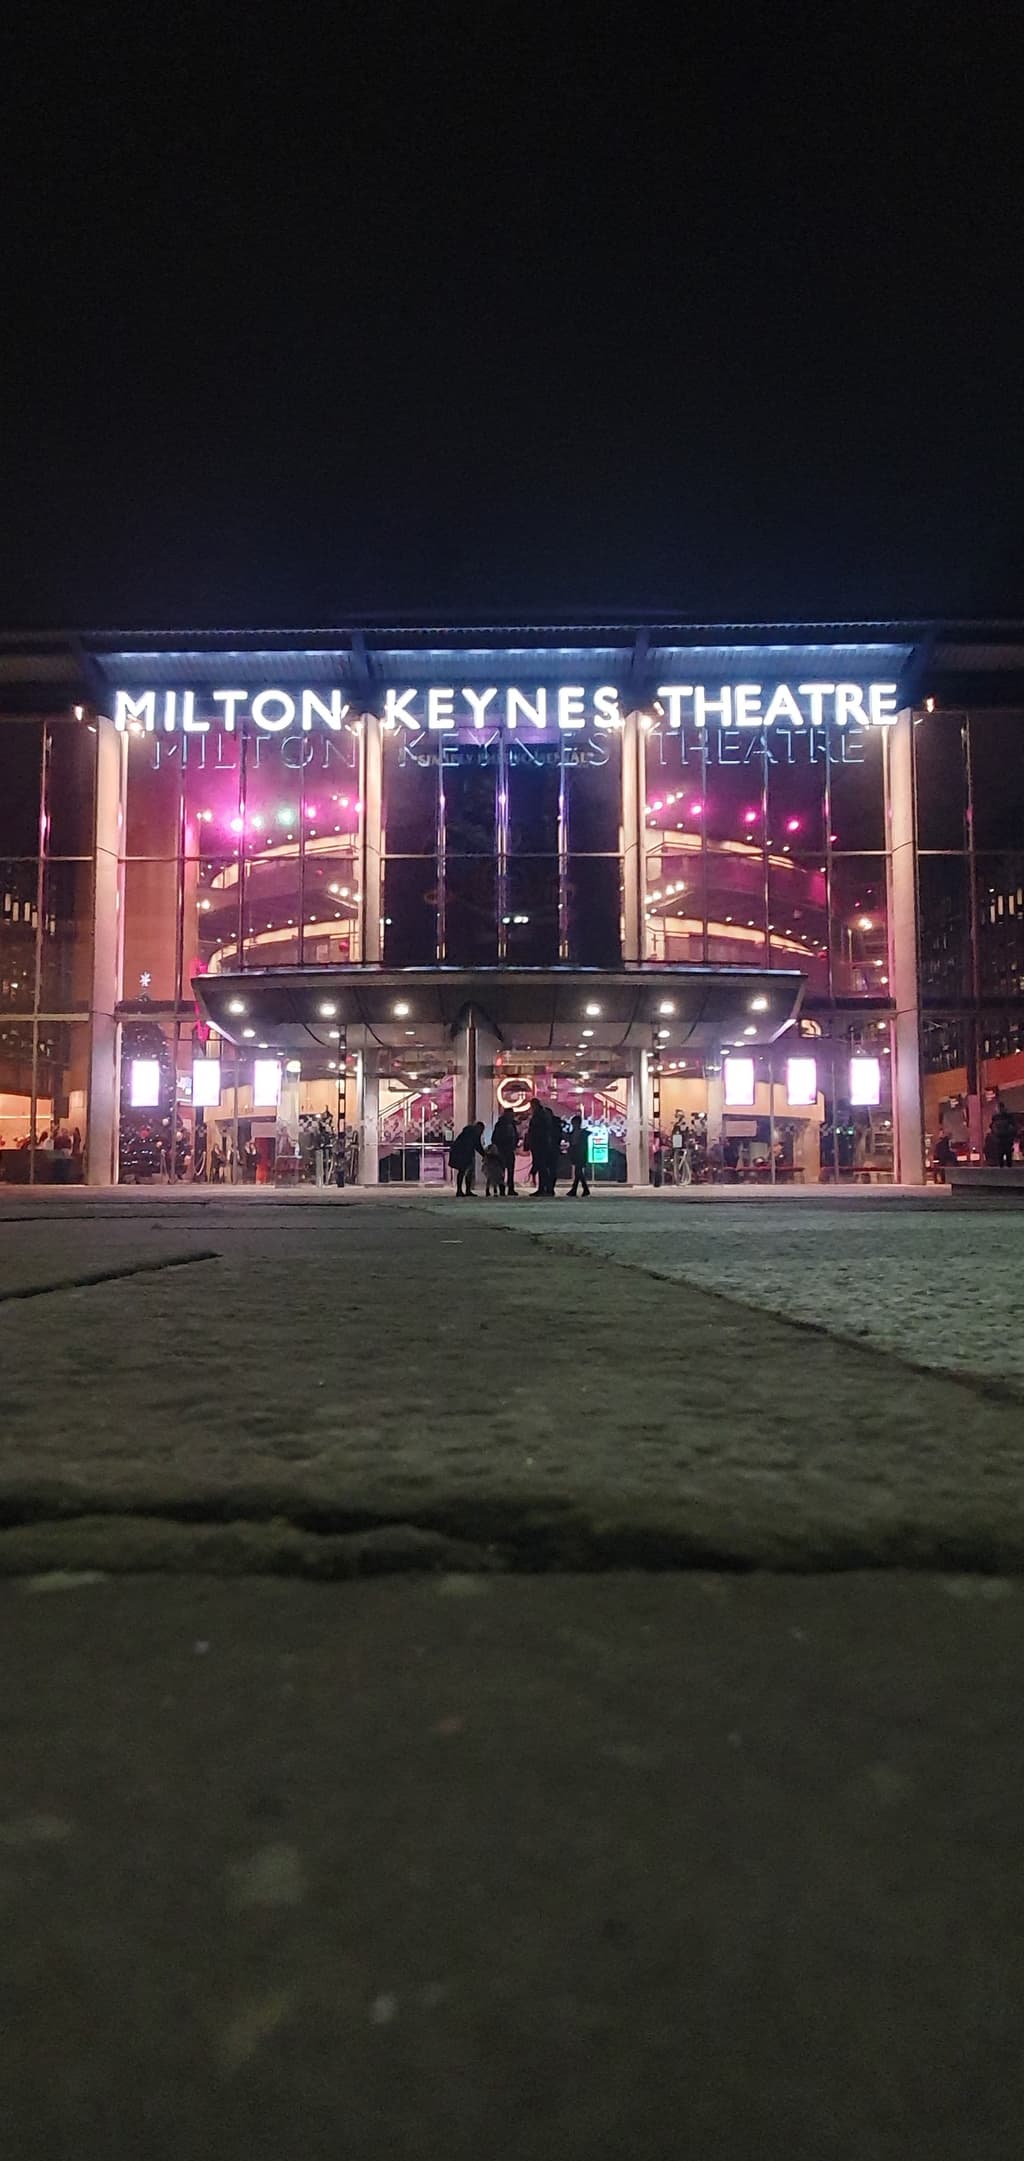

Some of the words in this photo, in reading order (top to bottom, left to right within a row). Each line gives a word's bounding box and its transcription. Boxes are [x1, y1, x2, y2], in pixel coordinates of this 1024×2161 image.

[114, 688, 345, 732] MILTON
[385, 687, 622, 730] KEYNES
[657, 683, 899, 728] THEATRE
[152, 733, 357, 769] MILTON
[653, 728, 866, 766] THEATRE
